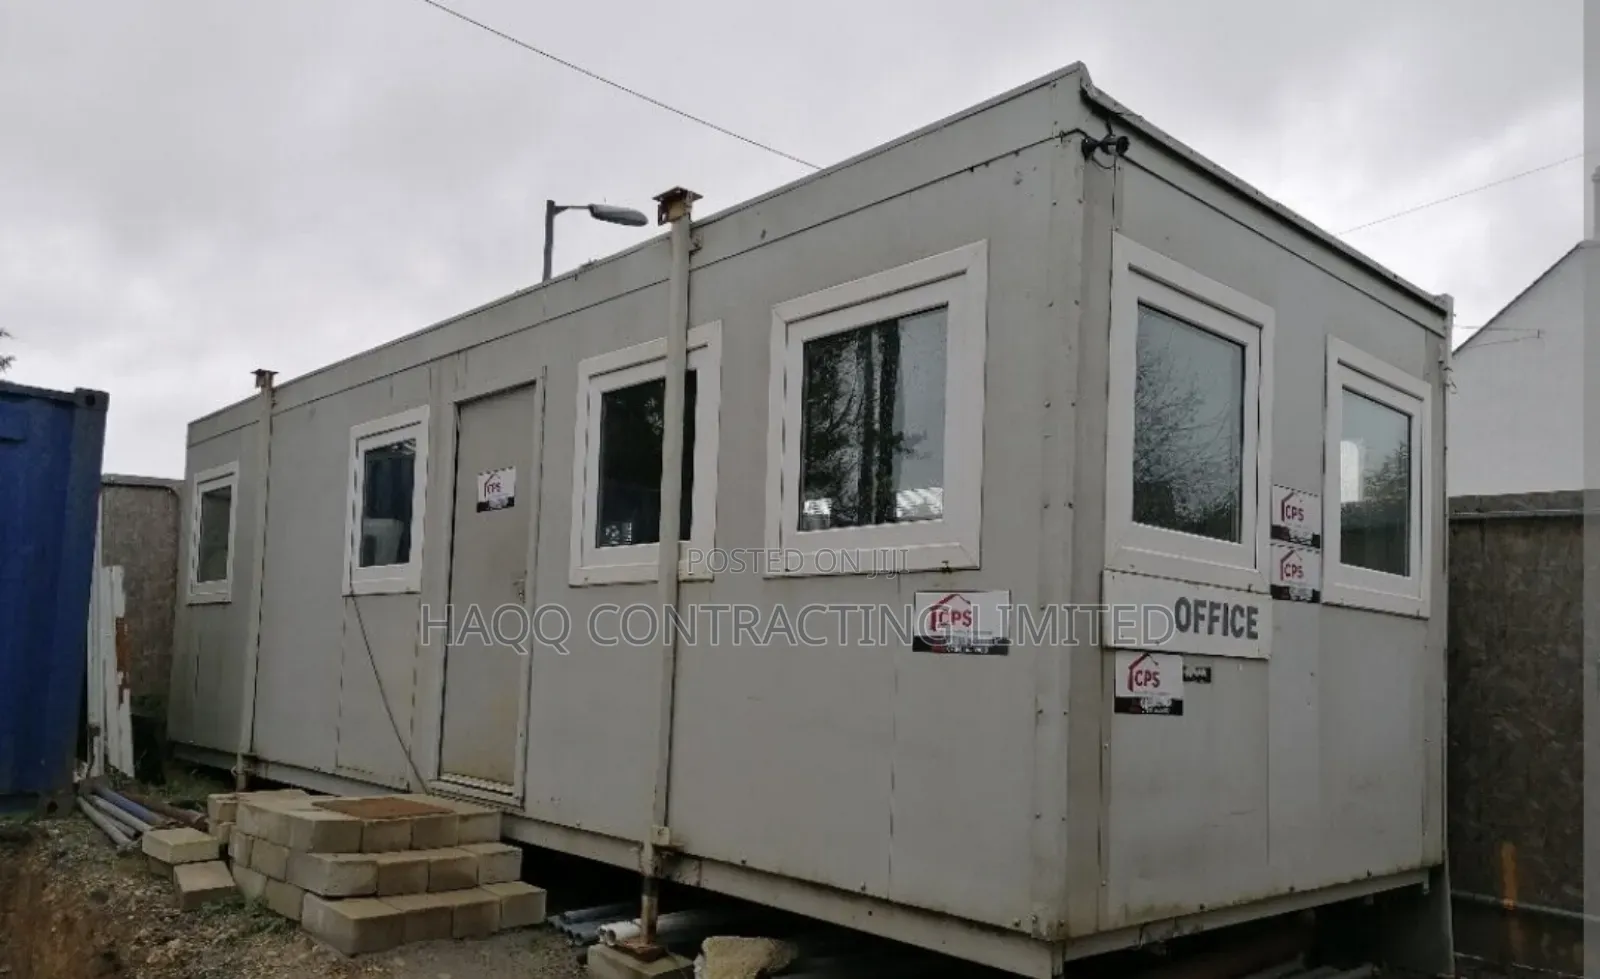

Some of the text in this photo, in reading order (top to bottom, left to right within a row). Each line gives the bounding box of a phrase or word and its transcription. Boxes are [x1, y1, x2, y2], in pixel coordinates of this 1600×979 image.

[1285, 504, 1304, 522] CPS
[1284, 563, 1304, 579] CPS
[937, 609, 972, 627] CPS
[1174, 596, 1260, 640] OFFICE
[1134, 669, 1161, 688] CPS
